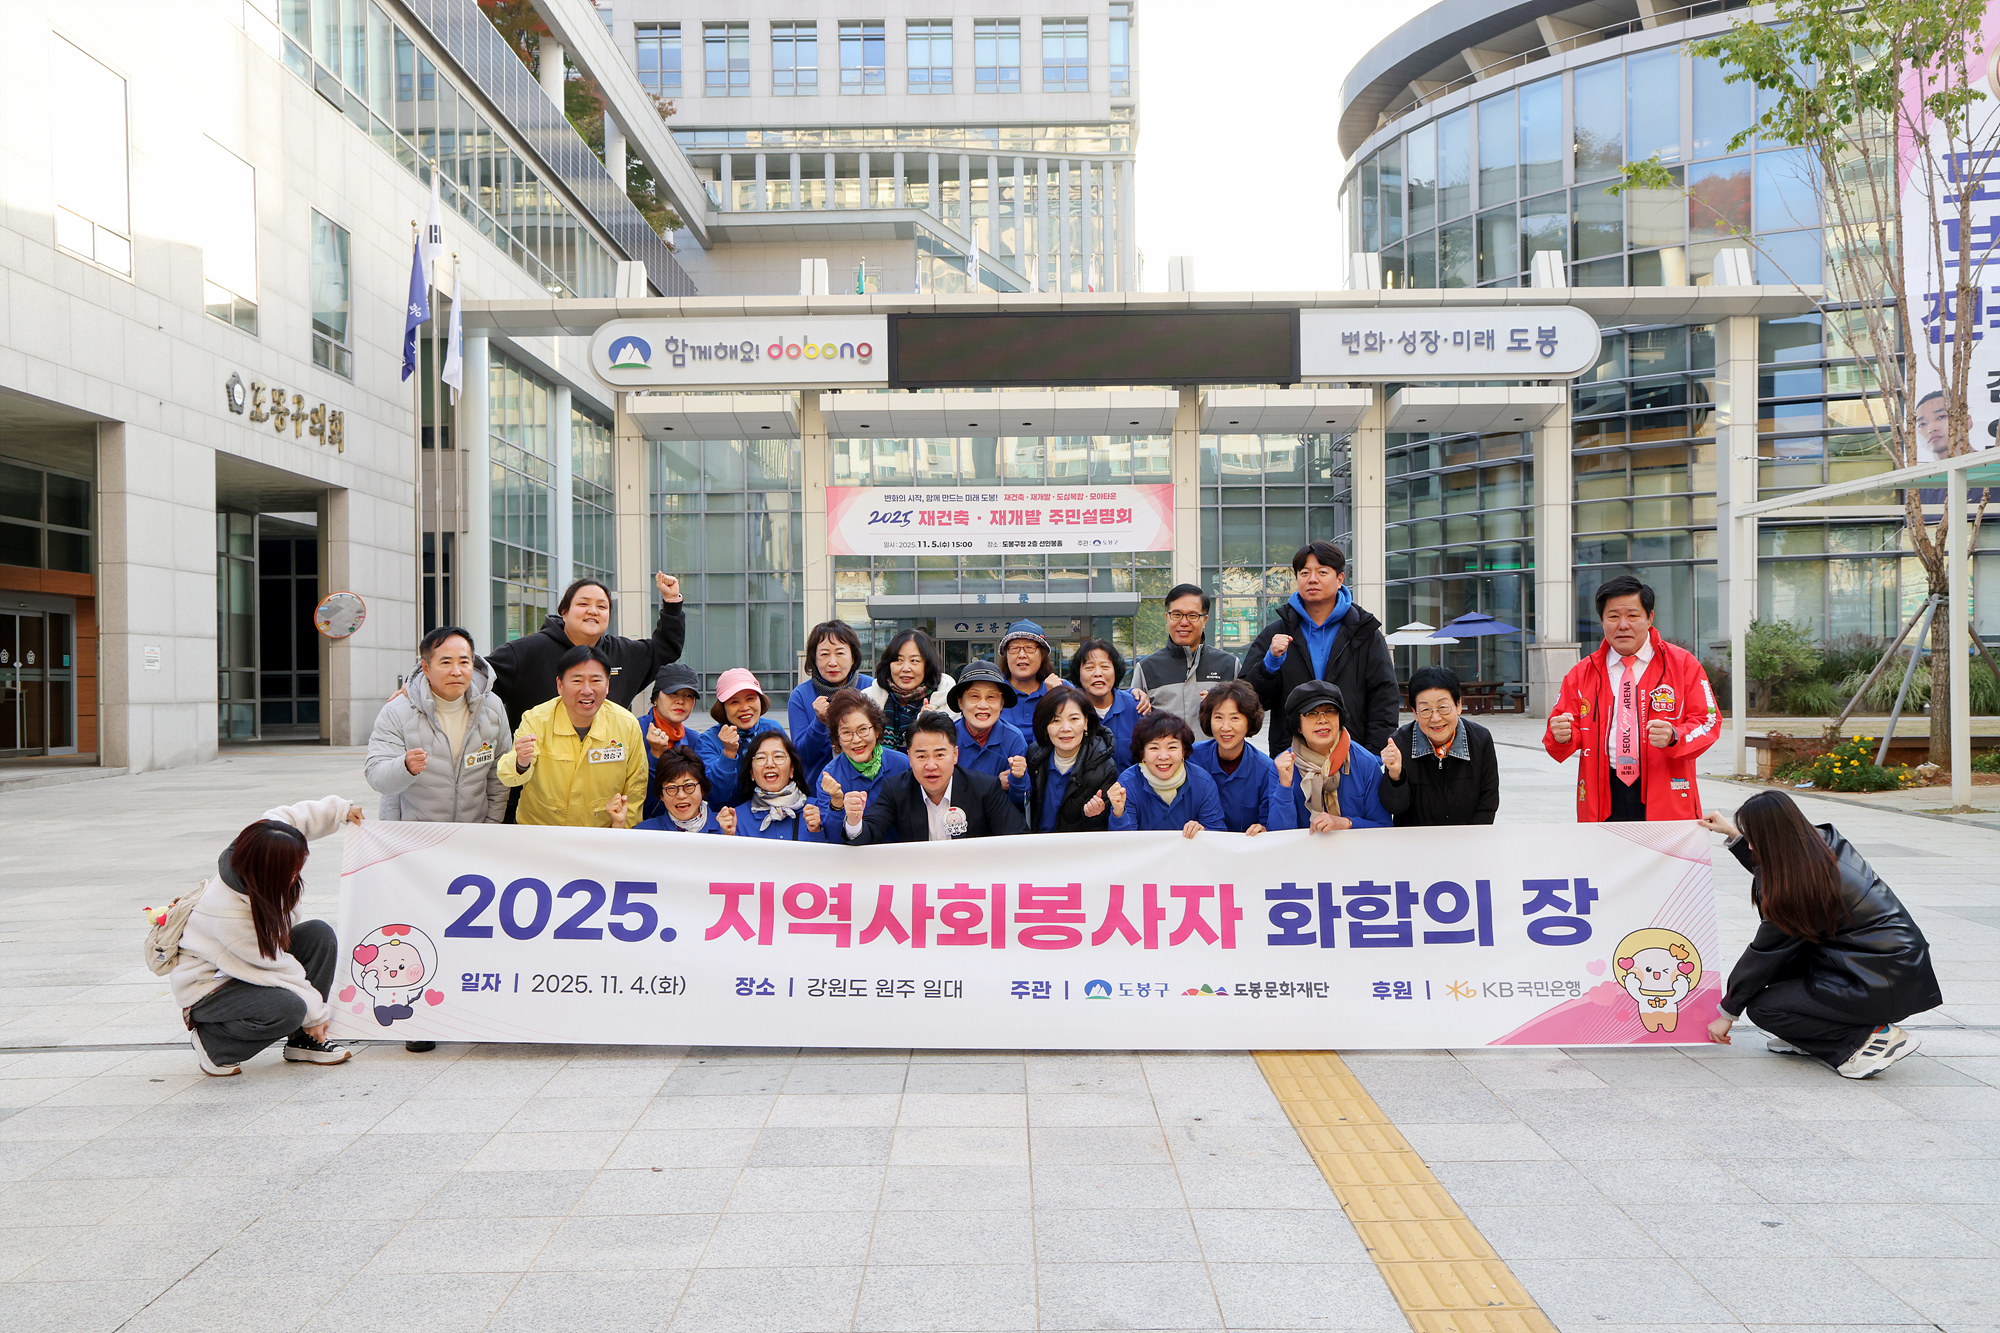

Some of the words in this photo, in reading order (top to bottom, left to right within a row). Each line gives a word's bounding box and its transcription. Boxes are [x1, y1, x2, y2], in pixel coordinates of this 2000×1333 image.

[665, 335, 760, 369] 함께해요!
[767, 335, 873, 366] dobong
[1506, 326, 1559, 360] 도봉
[249, 381, 344, 454] 도봉구의회
[884, 494, 906, 503] 변화의
[926, 494, 941, 503] 함께
[942, 494, 964, 502] 만드는
[965, 494, 980, 502] 미래
[981, 493, 998, 502] 도봉!
[1004, 493, 1025, 502] 재건축
[1030, 493, 1051, 502] 재개발
[1056, 493, 1085, 501] 도심복합
[1089, 492, 1117, 501] 모아타운
[868, 510, 914, 527] 2025
[918, 510, 970, 526] 재건축
[990, 509, 1042, 526] 재개발
[1049, 508, 1132, 525] 주민설명회
[1002, 540, 1026, 548] 도봉구청
[1027, 540, 1038, 548] 2층
[444, 873, 677, 943] 2025.
[704, 880, 1243, 950] 지역사회봉사자
[1264, 879, 1495, 949] 화합의
[1522, 877, 1599, 947] 장
[460, 972, 502, 993] 일자
[531, 974, 593, 994] 2025.
[601, 975, 624, 994] 11.
[630, 975, 687, 996] 4.(화)
[735, 976, 776, 996] 장소
[807, 978, 868, 998] 강원도
[875, 979, 916, 998] 원주
[923, 979, 963, 999] 일대
[1010, 980, 1052, 1000] 주관
[1118, 982, 1170, 998] 도봉구
[1233, 981, 1330, 999] 도봉문화재단
[1372, 980, 1412, 1000] 후원
